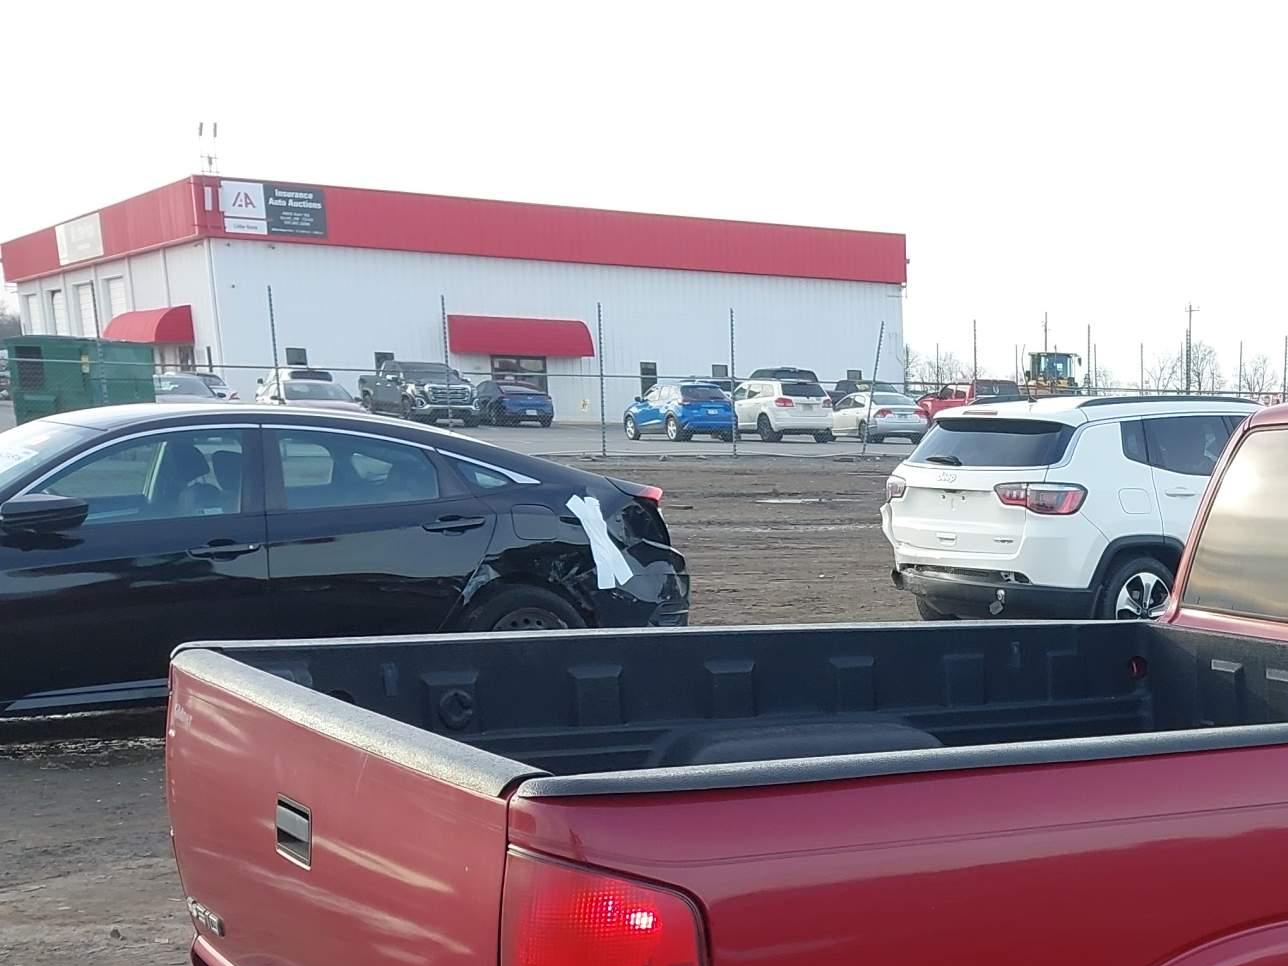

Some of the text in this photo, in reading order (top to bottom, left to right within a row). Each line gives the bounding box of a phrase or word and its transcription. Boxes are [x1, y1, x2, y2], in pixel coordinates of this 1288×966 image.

[274, 188, 314, 200] Insurance
[268, 197, 322, 209] Auto Auctions
